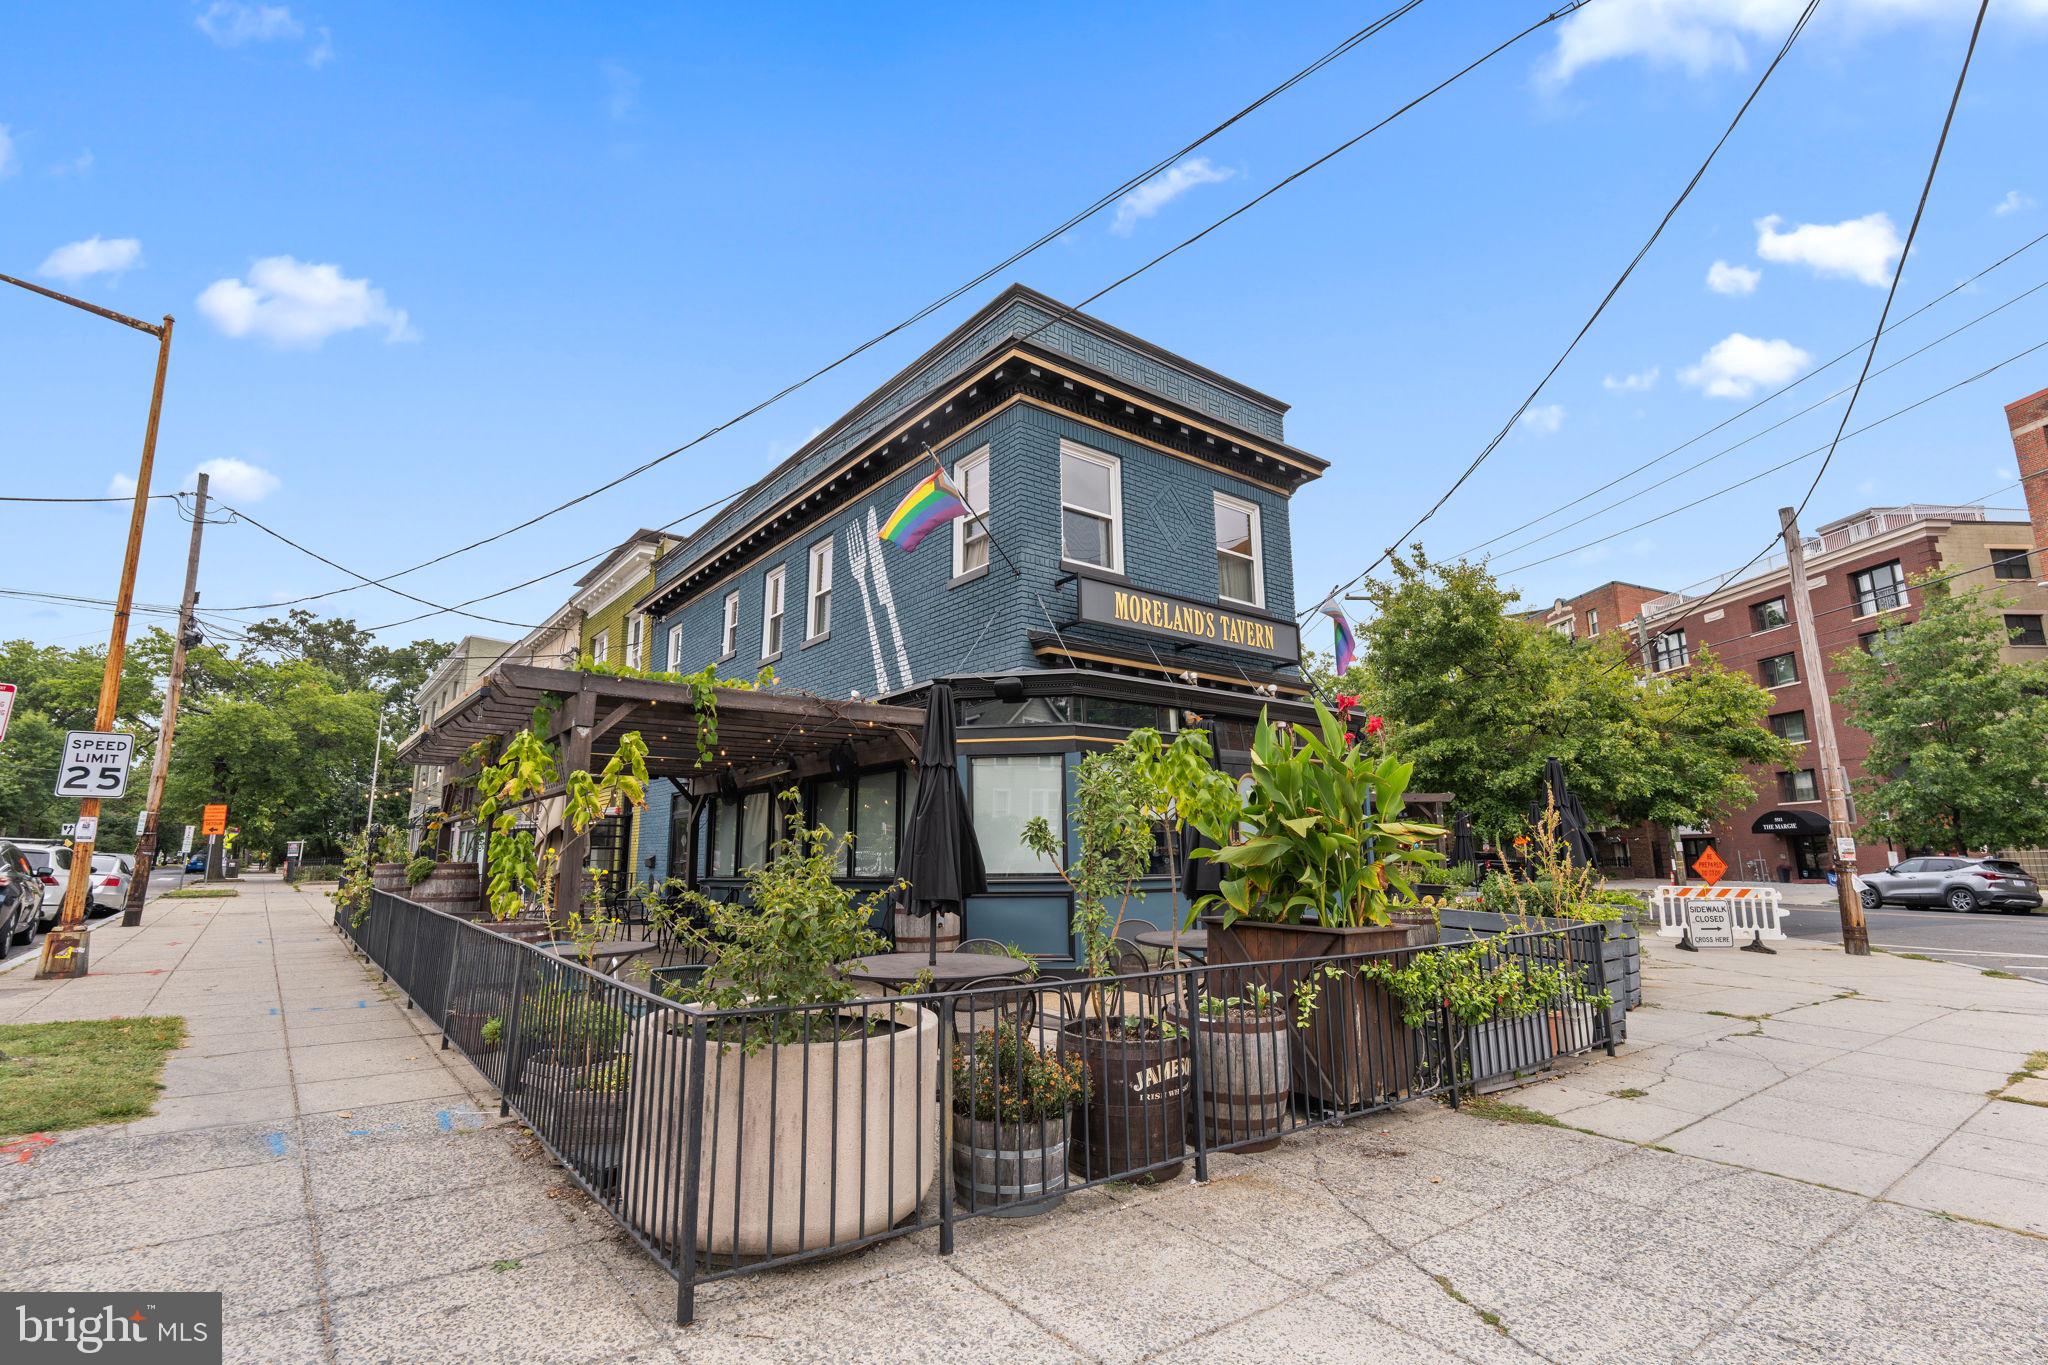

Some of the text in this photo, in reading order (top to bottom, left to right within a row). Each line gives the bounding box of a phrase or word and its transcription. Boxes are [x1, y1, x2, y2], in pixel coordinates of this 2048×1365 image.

[1114, 591, 1274, 650] MORELAND'S TAVERN
[72, 740, 127, 751] SPEED
[75, 753, 119, 764] LIMIT
[63, 766, 121, 790] 25
[1698, 861, 1723, 869] PREPARED
[1689, 905, 1726, 913] SIDEWALK
[1695, 915, 1724, 923] CLOSED
